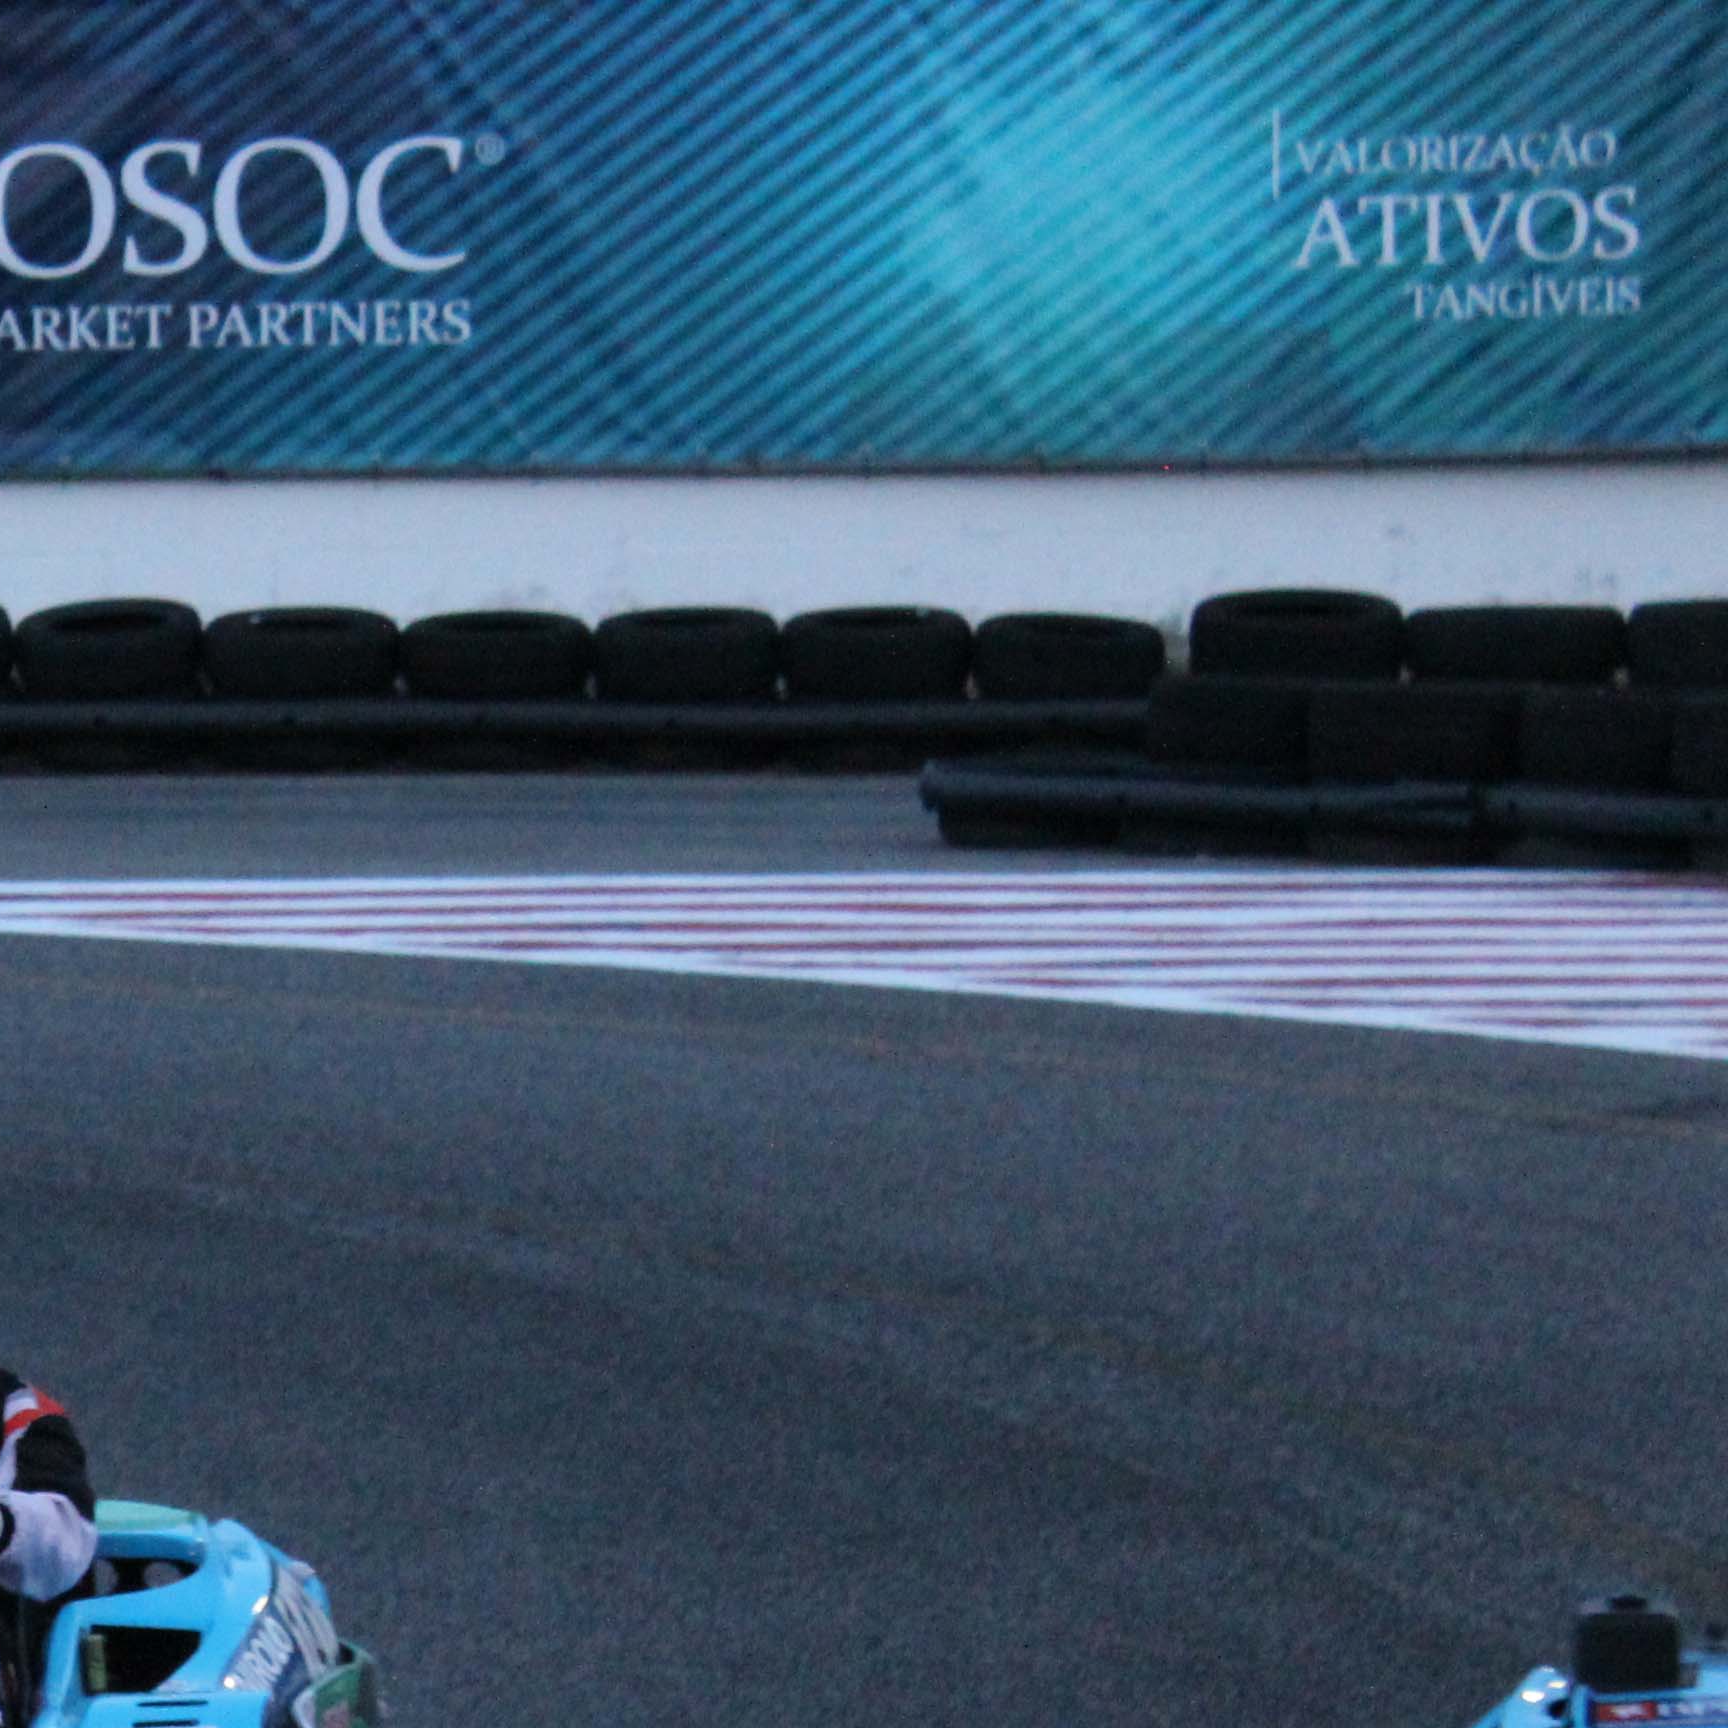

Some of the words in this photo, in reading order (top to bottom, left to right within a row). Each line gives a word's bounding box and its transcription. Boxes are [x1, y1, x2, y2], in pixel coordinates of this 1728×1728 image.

[1296, 122, 1617, 176] VALORIZAÇÃO
[1293, 184, 1642, 269] ATIVOS
[1409, 272, 1641, 320] TANGÍVEIS
[186, 299, 473, 349] PARTNERS
